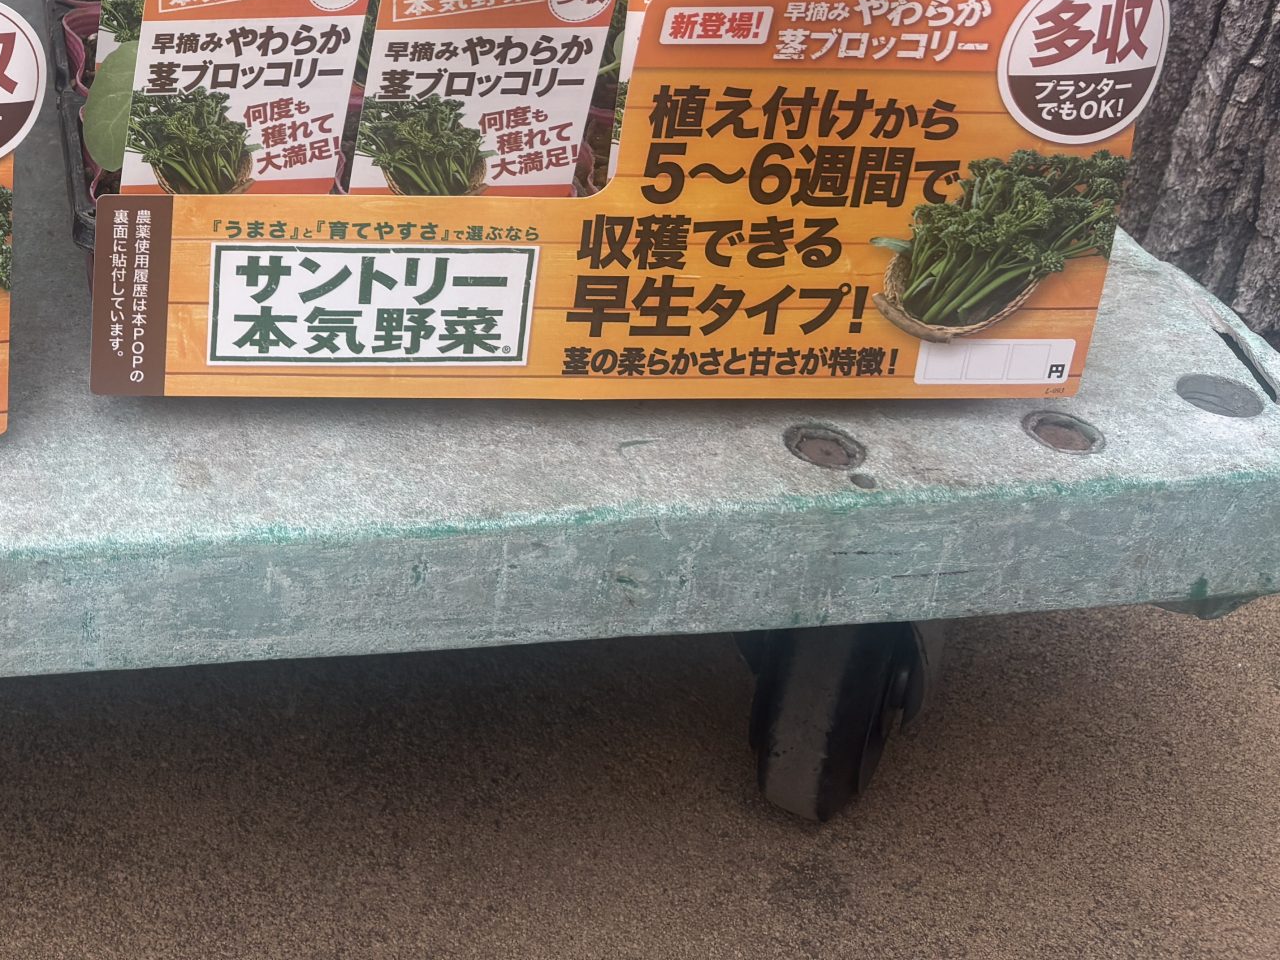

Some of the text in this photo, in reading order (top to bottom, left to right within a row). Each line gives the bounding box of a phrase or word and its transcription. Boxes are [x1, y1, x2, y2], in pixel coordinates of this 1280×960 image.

[151, 24, 351, 58] 早摘みやわらか
[669, 10, 763, 39] 新登場!
[385, 34, 594, 66] 早摘みやわらか
[774, 27, 989, 62] 茎ブロッコリー
[146, 58, 344, 94] 茎ブロッコリー
[378, 68, 585, 100] 茎ブロッコリー
[1034, 80, 1133, 100] プランター
[243, 97, 310, 128] 何度も
[478, 105, 549, 135] 何度も
[648, 85, 960, 140] 植え付けから
[1037, 97, 1125, 122] でもOK!
[262, 113, 335, 149] 獲れて
[496, 122, 573, 155] 獲れて
[256, 135, 342, 175] 大満足!
[491, 143, 580, 180] 大満足!
[577, 214, 843, 271] 収穫できる
[109, 209, 130, 358] 裏面に貼付しています。
[130, 209, 152, 383] 農薬使用履歴は本POPの
[235, 255, 508, 305] サントリー
[566, 274, 870, 337] 早生タイプ!
[233, 305, 504, 355] 本気野菜
[562, 346, 899, 377] 茎の柔らかさと甘さが特徴!
[1048, 363, 1065, 379] 円
